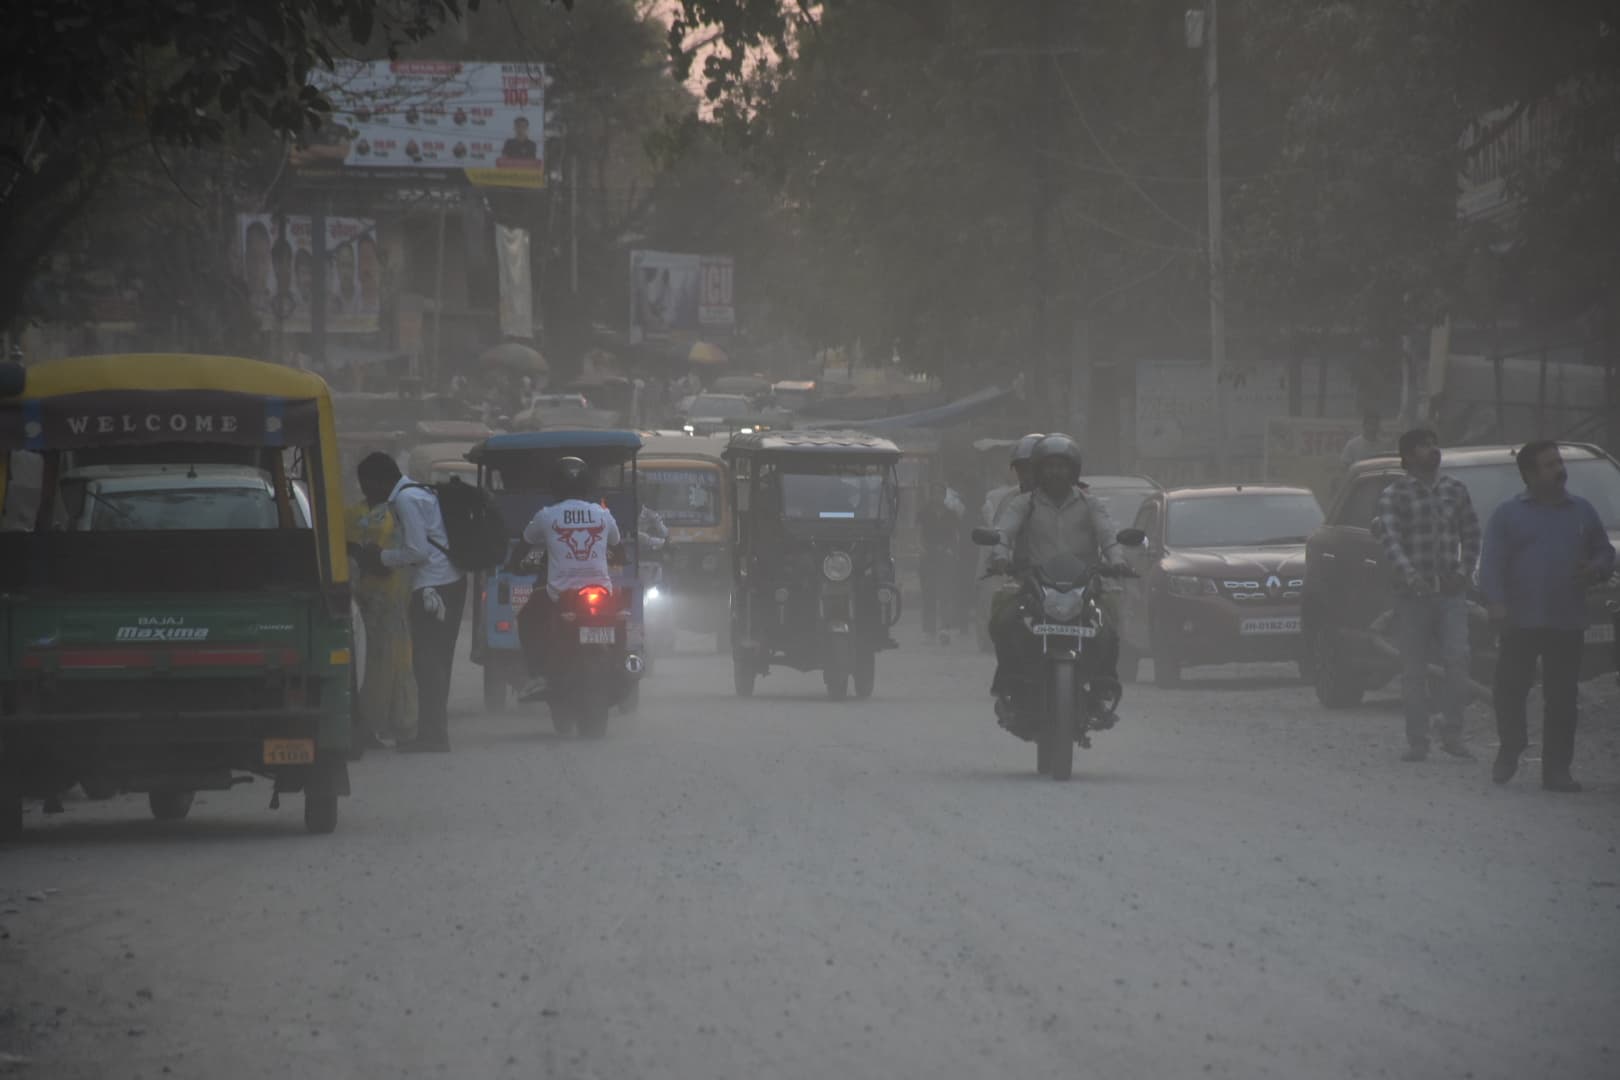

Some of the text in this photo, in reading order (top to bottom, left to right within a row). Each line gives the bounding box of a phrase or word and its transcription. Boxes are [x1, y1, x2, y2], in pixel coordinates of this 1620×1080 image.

[66, 414, 238, 435] WELCOME
[563, 509, 596, 525] BULL
[138, 616, 184, 626] BAJAJ
[115, 626, 209, 641] Maxima
